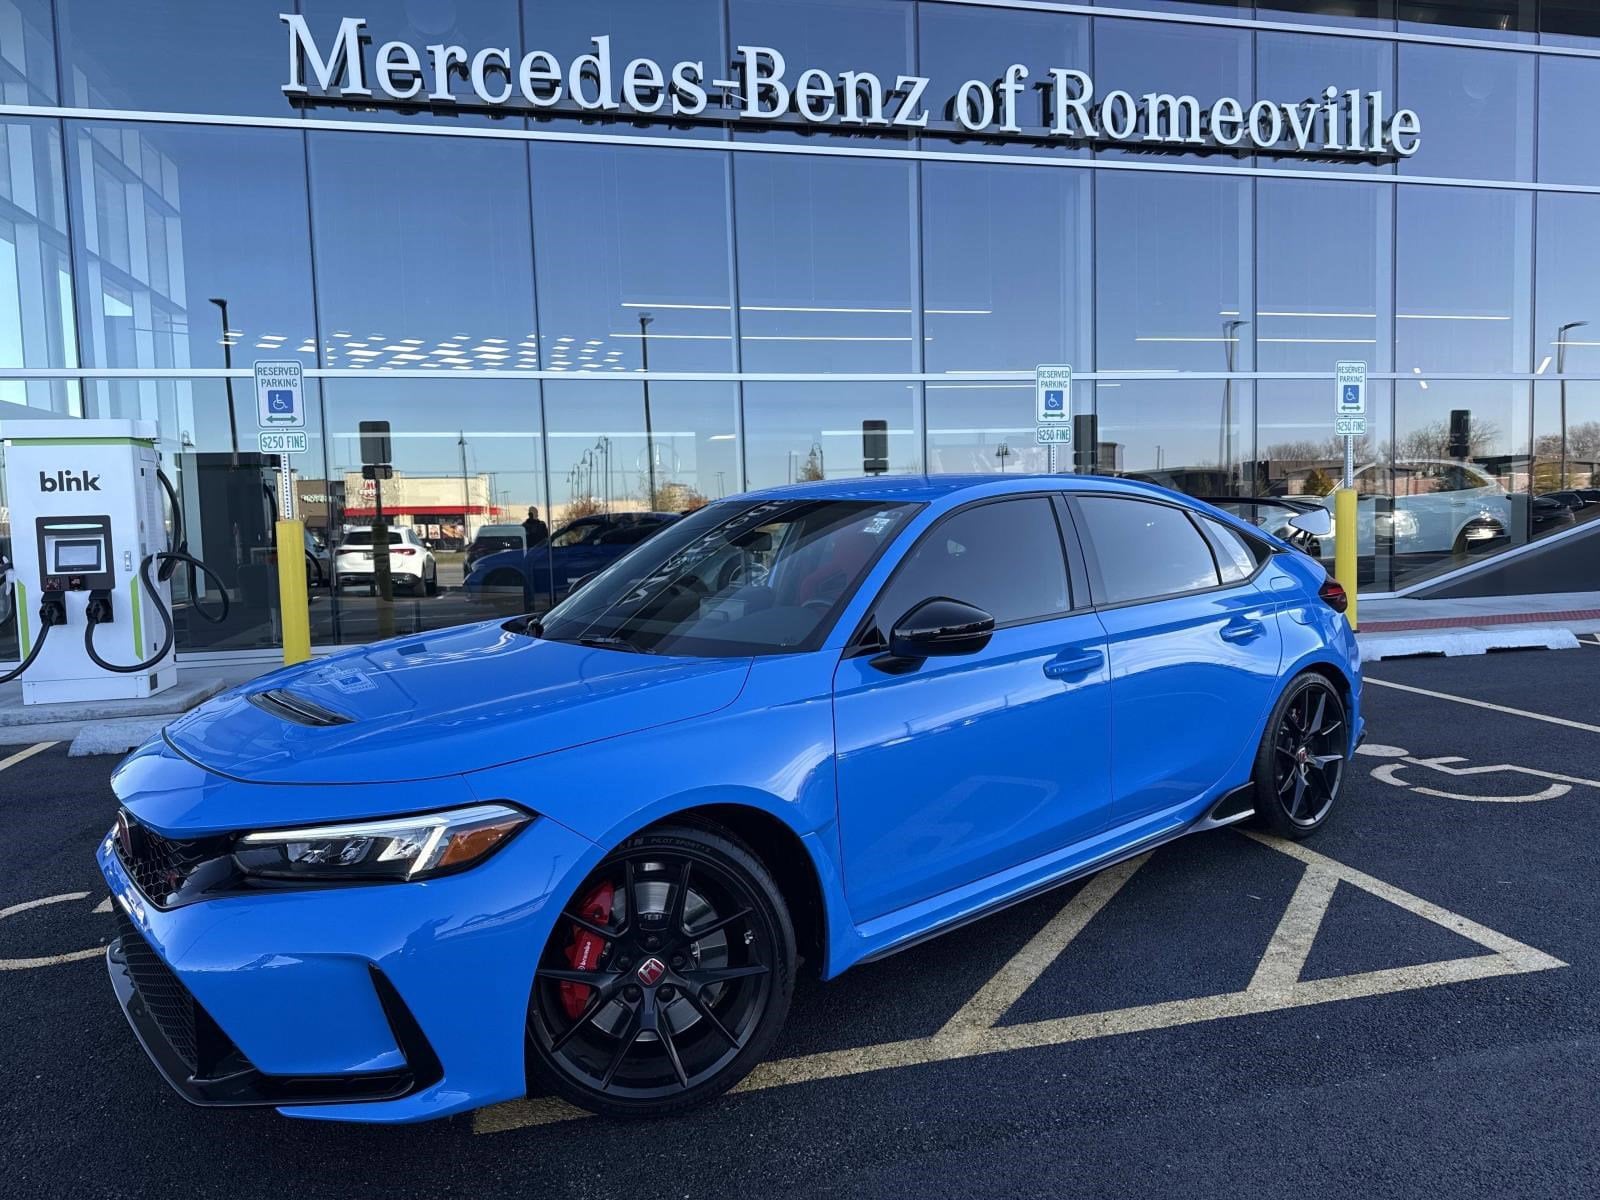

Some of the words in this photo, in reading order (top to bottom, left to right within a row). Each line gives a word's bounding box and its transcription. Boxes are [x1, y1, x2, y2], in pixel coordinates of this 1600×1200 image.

[279, 13, 930, 128] Mercedes-Benz
[957, 63, 1029, 132] of
[1049, 68, 1422, 156] Romeoville
[257, 366, 300, 376] RESERVED
[1039, 370, 1069, 379] RESERVED
[1338, 366, 1364, 374] RESERVED
[261, 378, 298, 388] PARKING
[1339, 375, 1363, 383] PARKING
[1040, 380, 1068, 389] PARKING
[1353, 421, 1365, 432] FINE
[1056, 429, 1069, 440] FINE
[262, 435, 284, 449] $250
[286, 435, 305, 449] FINE
[39, 469, 101, 493] blink
